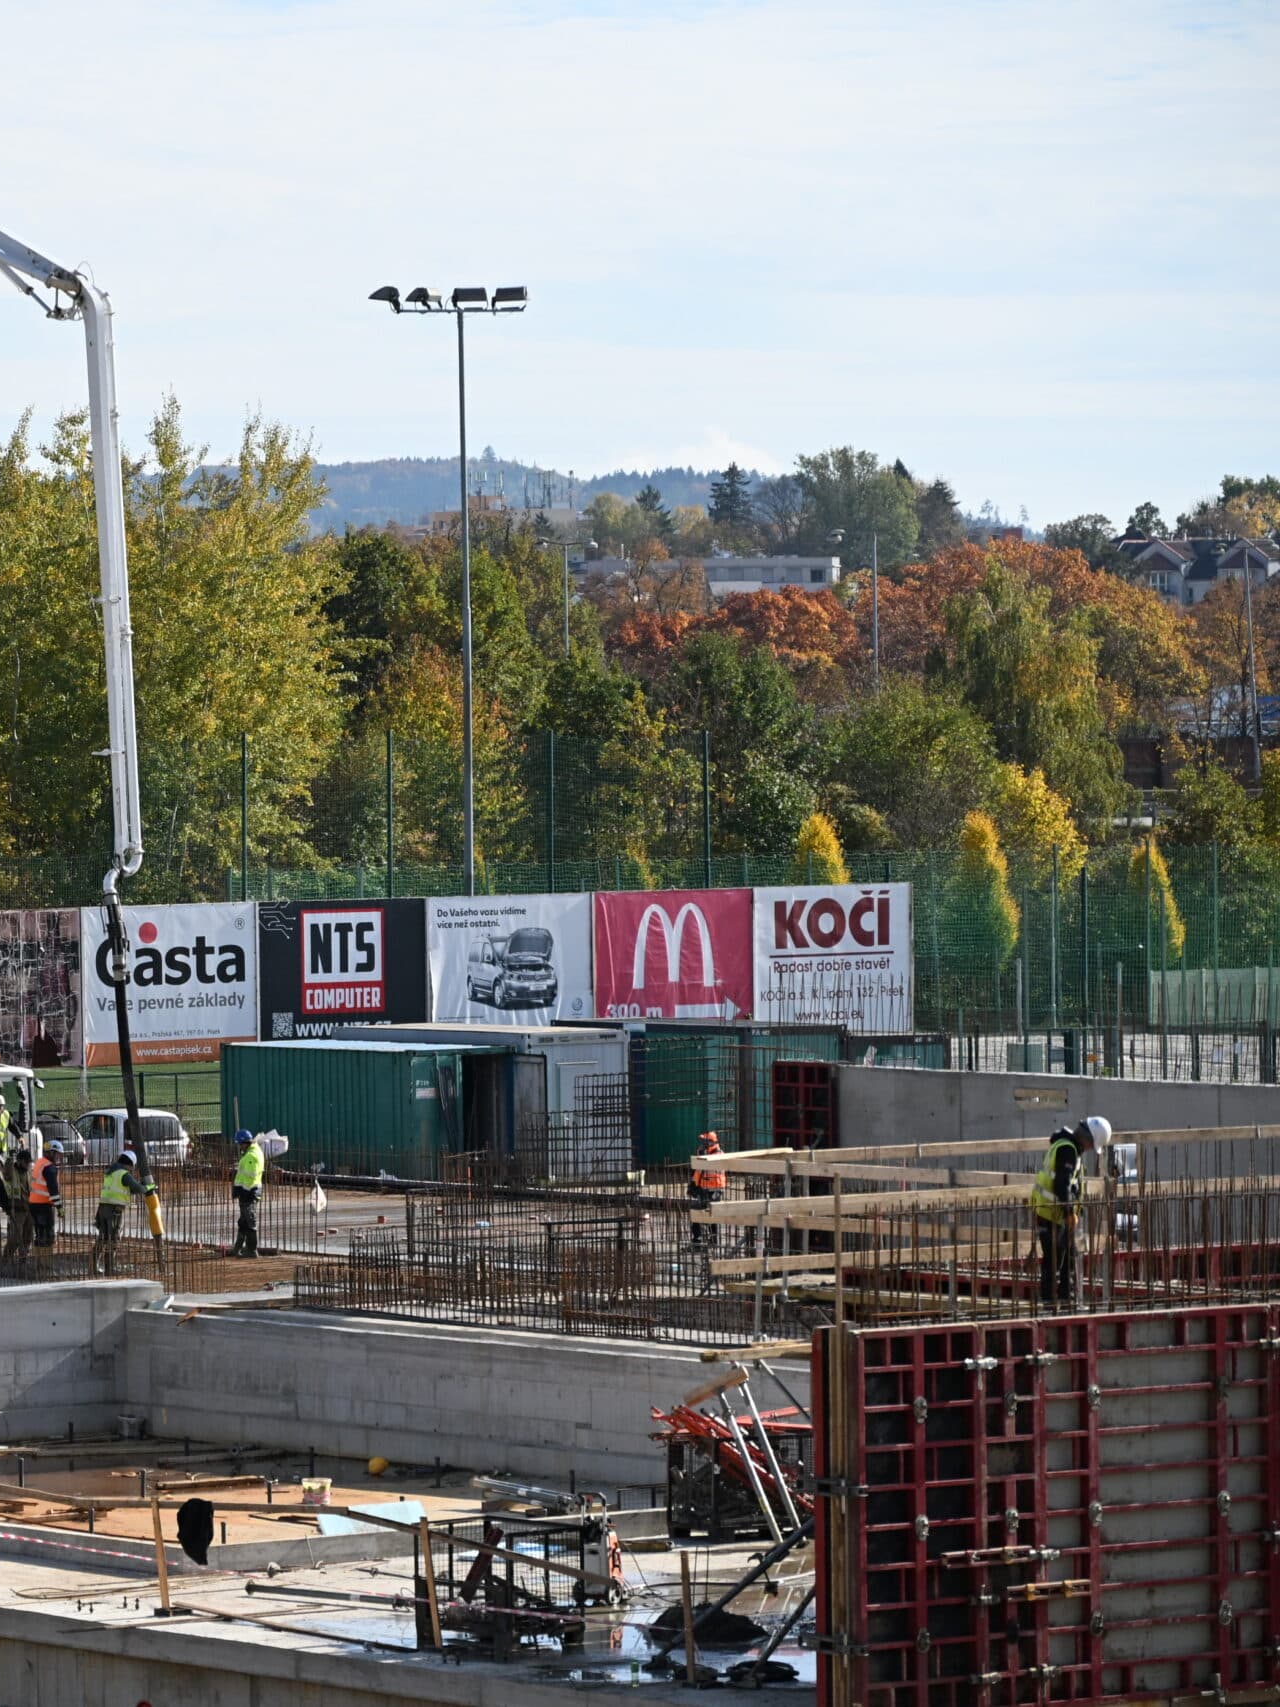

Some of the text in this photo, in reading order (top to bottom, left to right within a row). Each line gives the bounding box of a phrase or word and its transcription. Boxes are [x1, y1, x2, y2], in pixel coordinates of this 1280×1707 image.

[437, 908, 448, 917] Do
[449, 907, 478, 917] Vašeho
[774, 889, 890, 949] KOČÍ
[454, 919, 468, 929] než
[310, 922, 376, 974] NTS
[773, 957, 890, 974] Radost dobře stavět
[97, 992, 245, 1013] Vae pevné základy
[306, 987, 381, 1010] COMPUTER
[608, 1003, 663, 1018] 300 m
[136, 1045, 213, 1057] www.castapisek.cz
